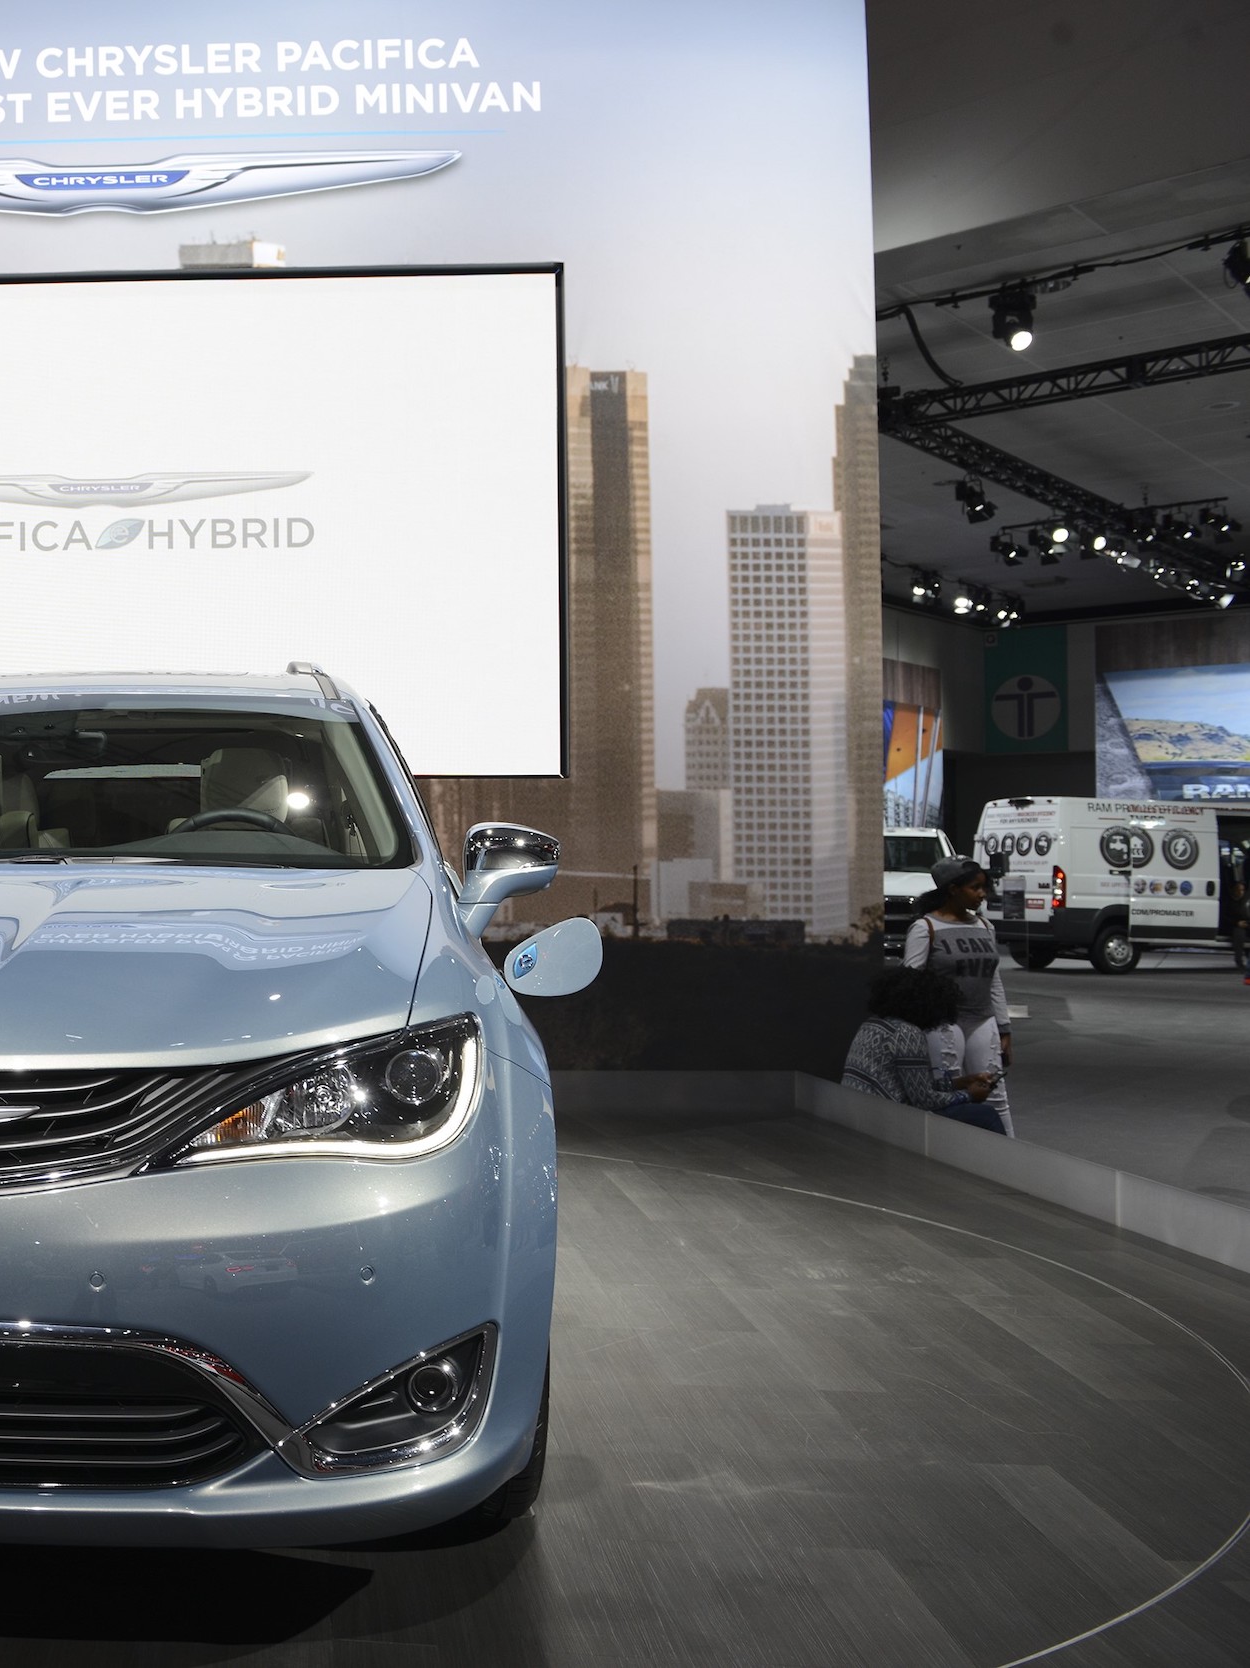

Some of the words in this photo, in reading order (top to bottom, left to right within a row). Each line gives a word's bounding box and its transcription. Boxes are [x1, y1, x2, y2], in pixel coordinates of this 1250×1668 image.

[36, 43, 262, 79] CHRYSLER
[277, 37, 480, 72] PACIFICA
[47, 89, 161, 123] EVER
[175, 85, 340, 119] HYBRID
[355, 81, 542, 115] MINIVAN
[33, 171, 170, 187] CHRYSLER
[59, 484, 141, 492] CHRYSLER
[147, 517, 315, 549] HYBRID
[1087, 803, 1113, 813] RAM
[940, 939, 952, 955] I
